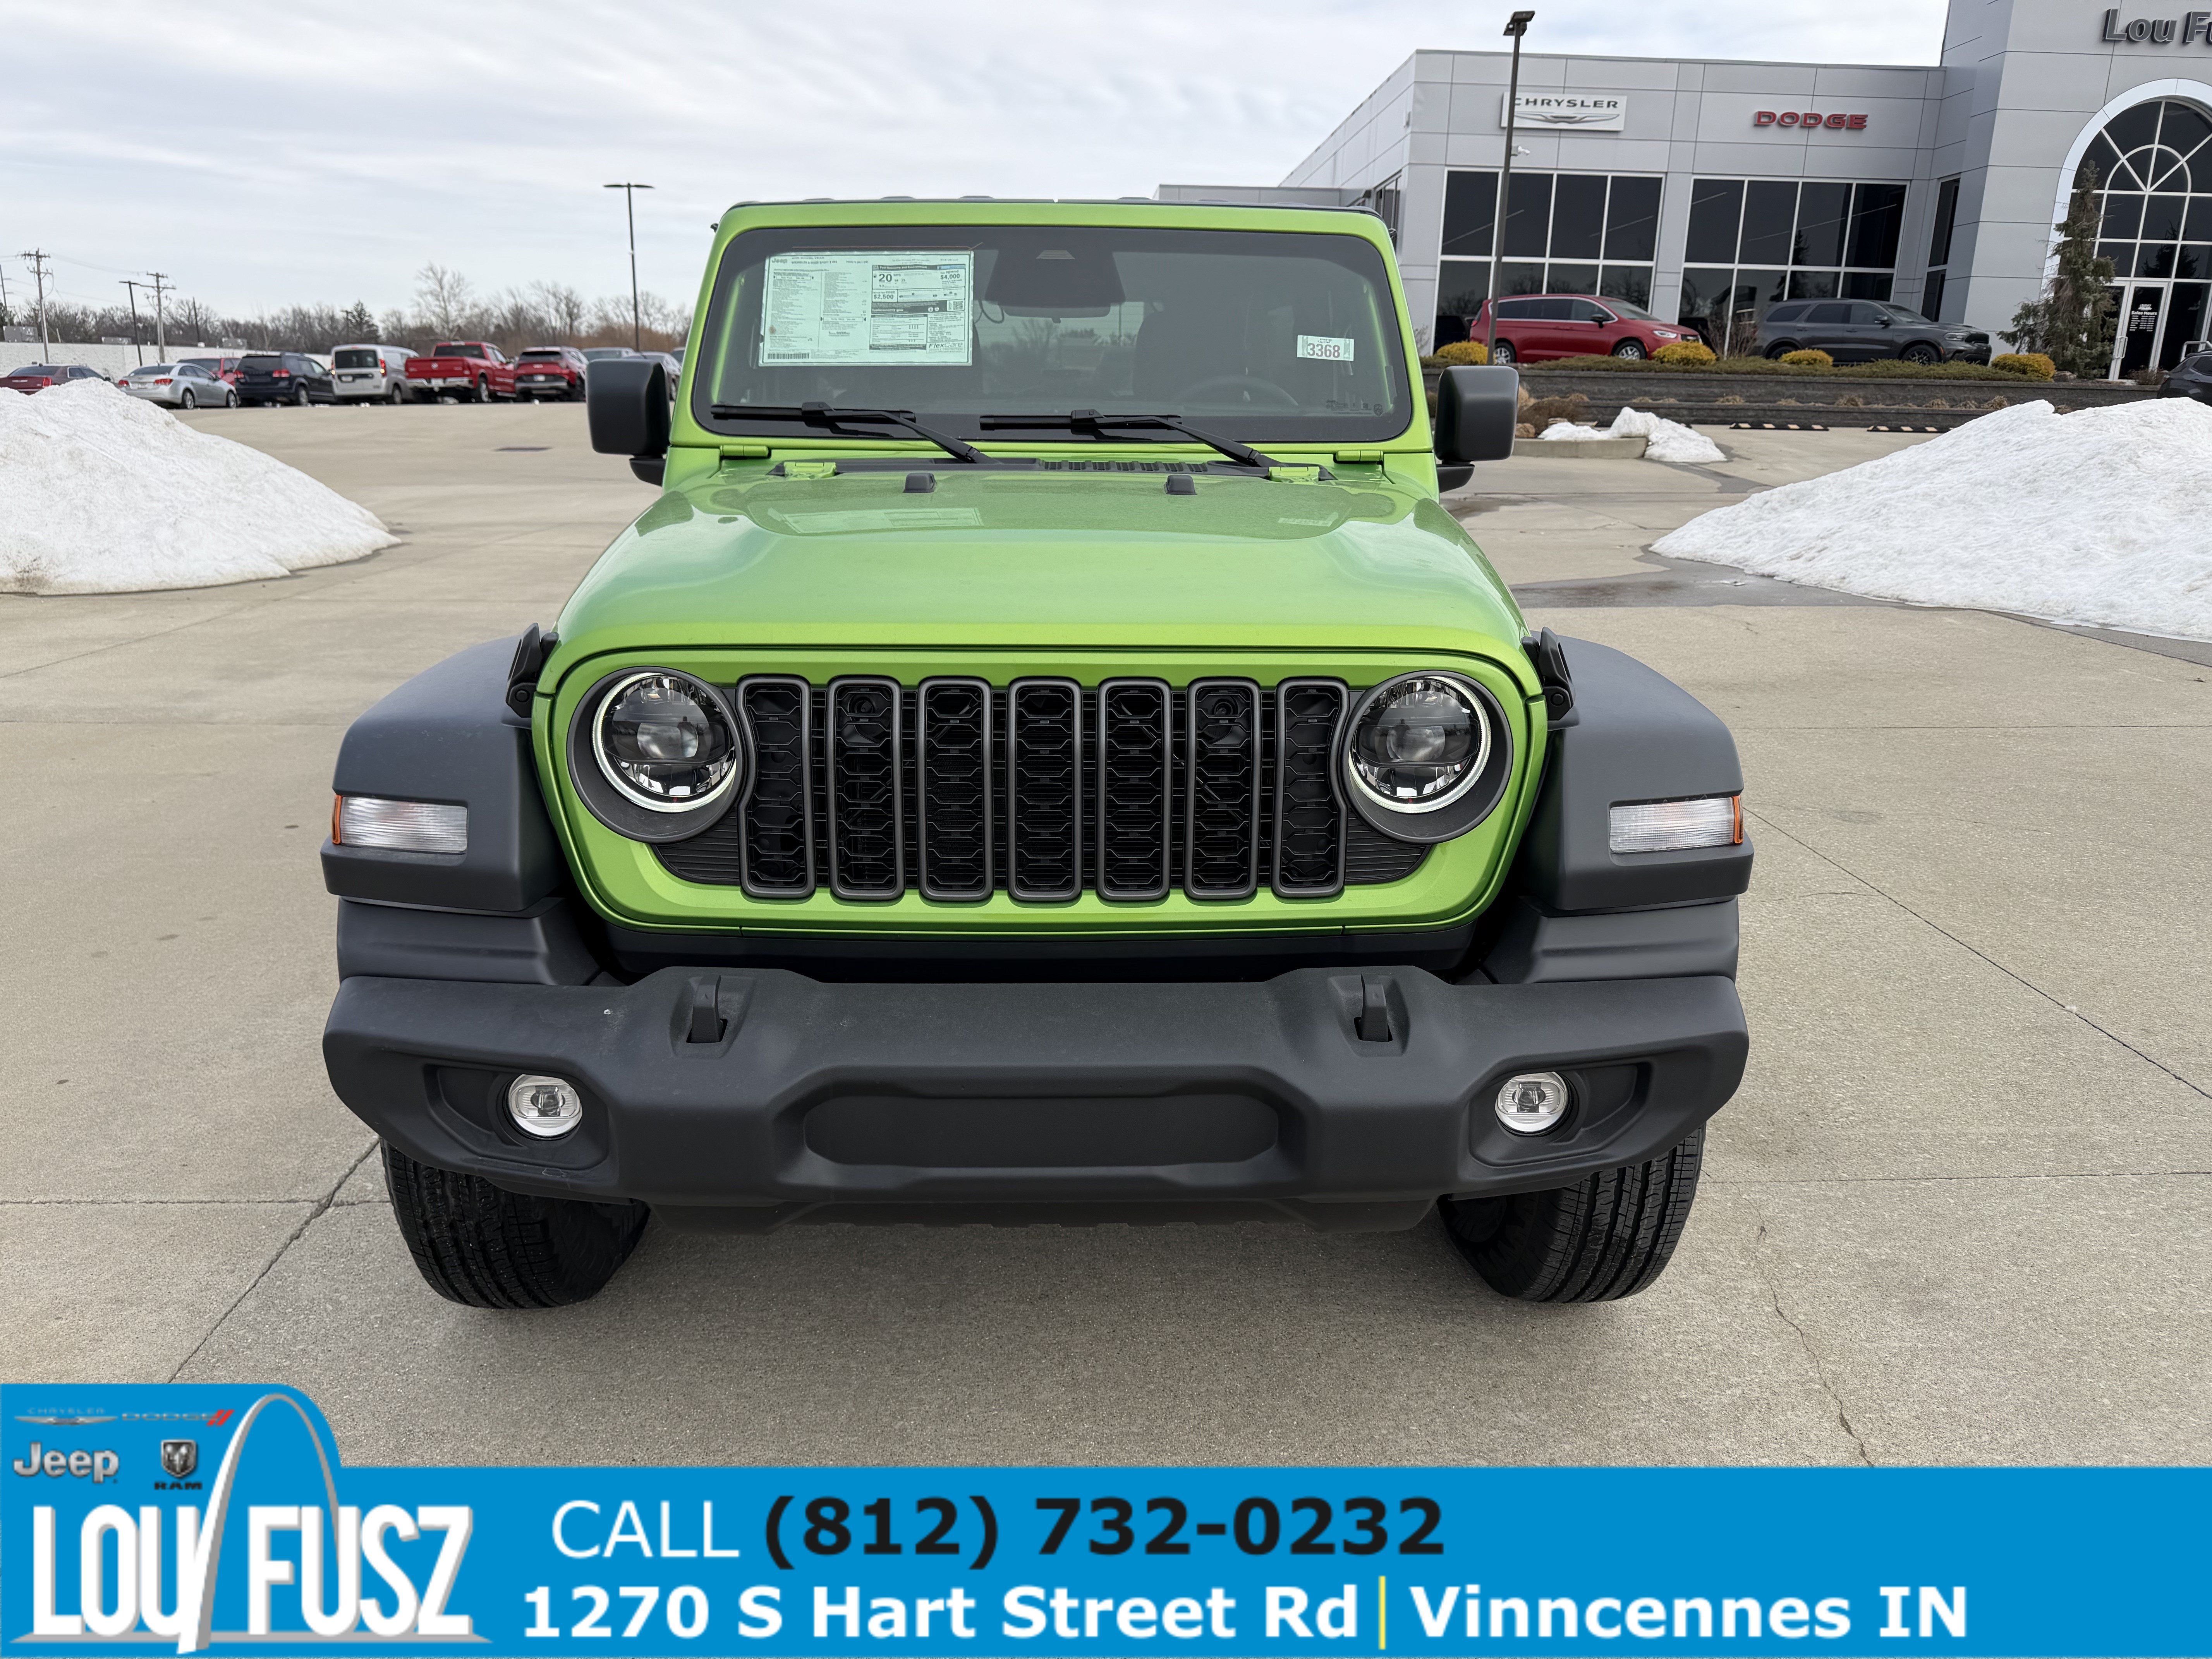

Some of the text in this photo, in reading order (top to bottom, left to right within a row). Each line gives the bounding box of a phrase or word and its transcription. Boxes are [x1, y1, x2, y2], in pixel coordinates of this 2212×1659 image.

[2102, 9, 2177, 42] Lou
[1754, 111, 1868, 129] DODGE
[879, 273, 892, 282] 20
[1307, 343, 1340, 358] 3368
